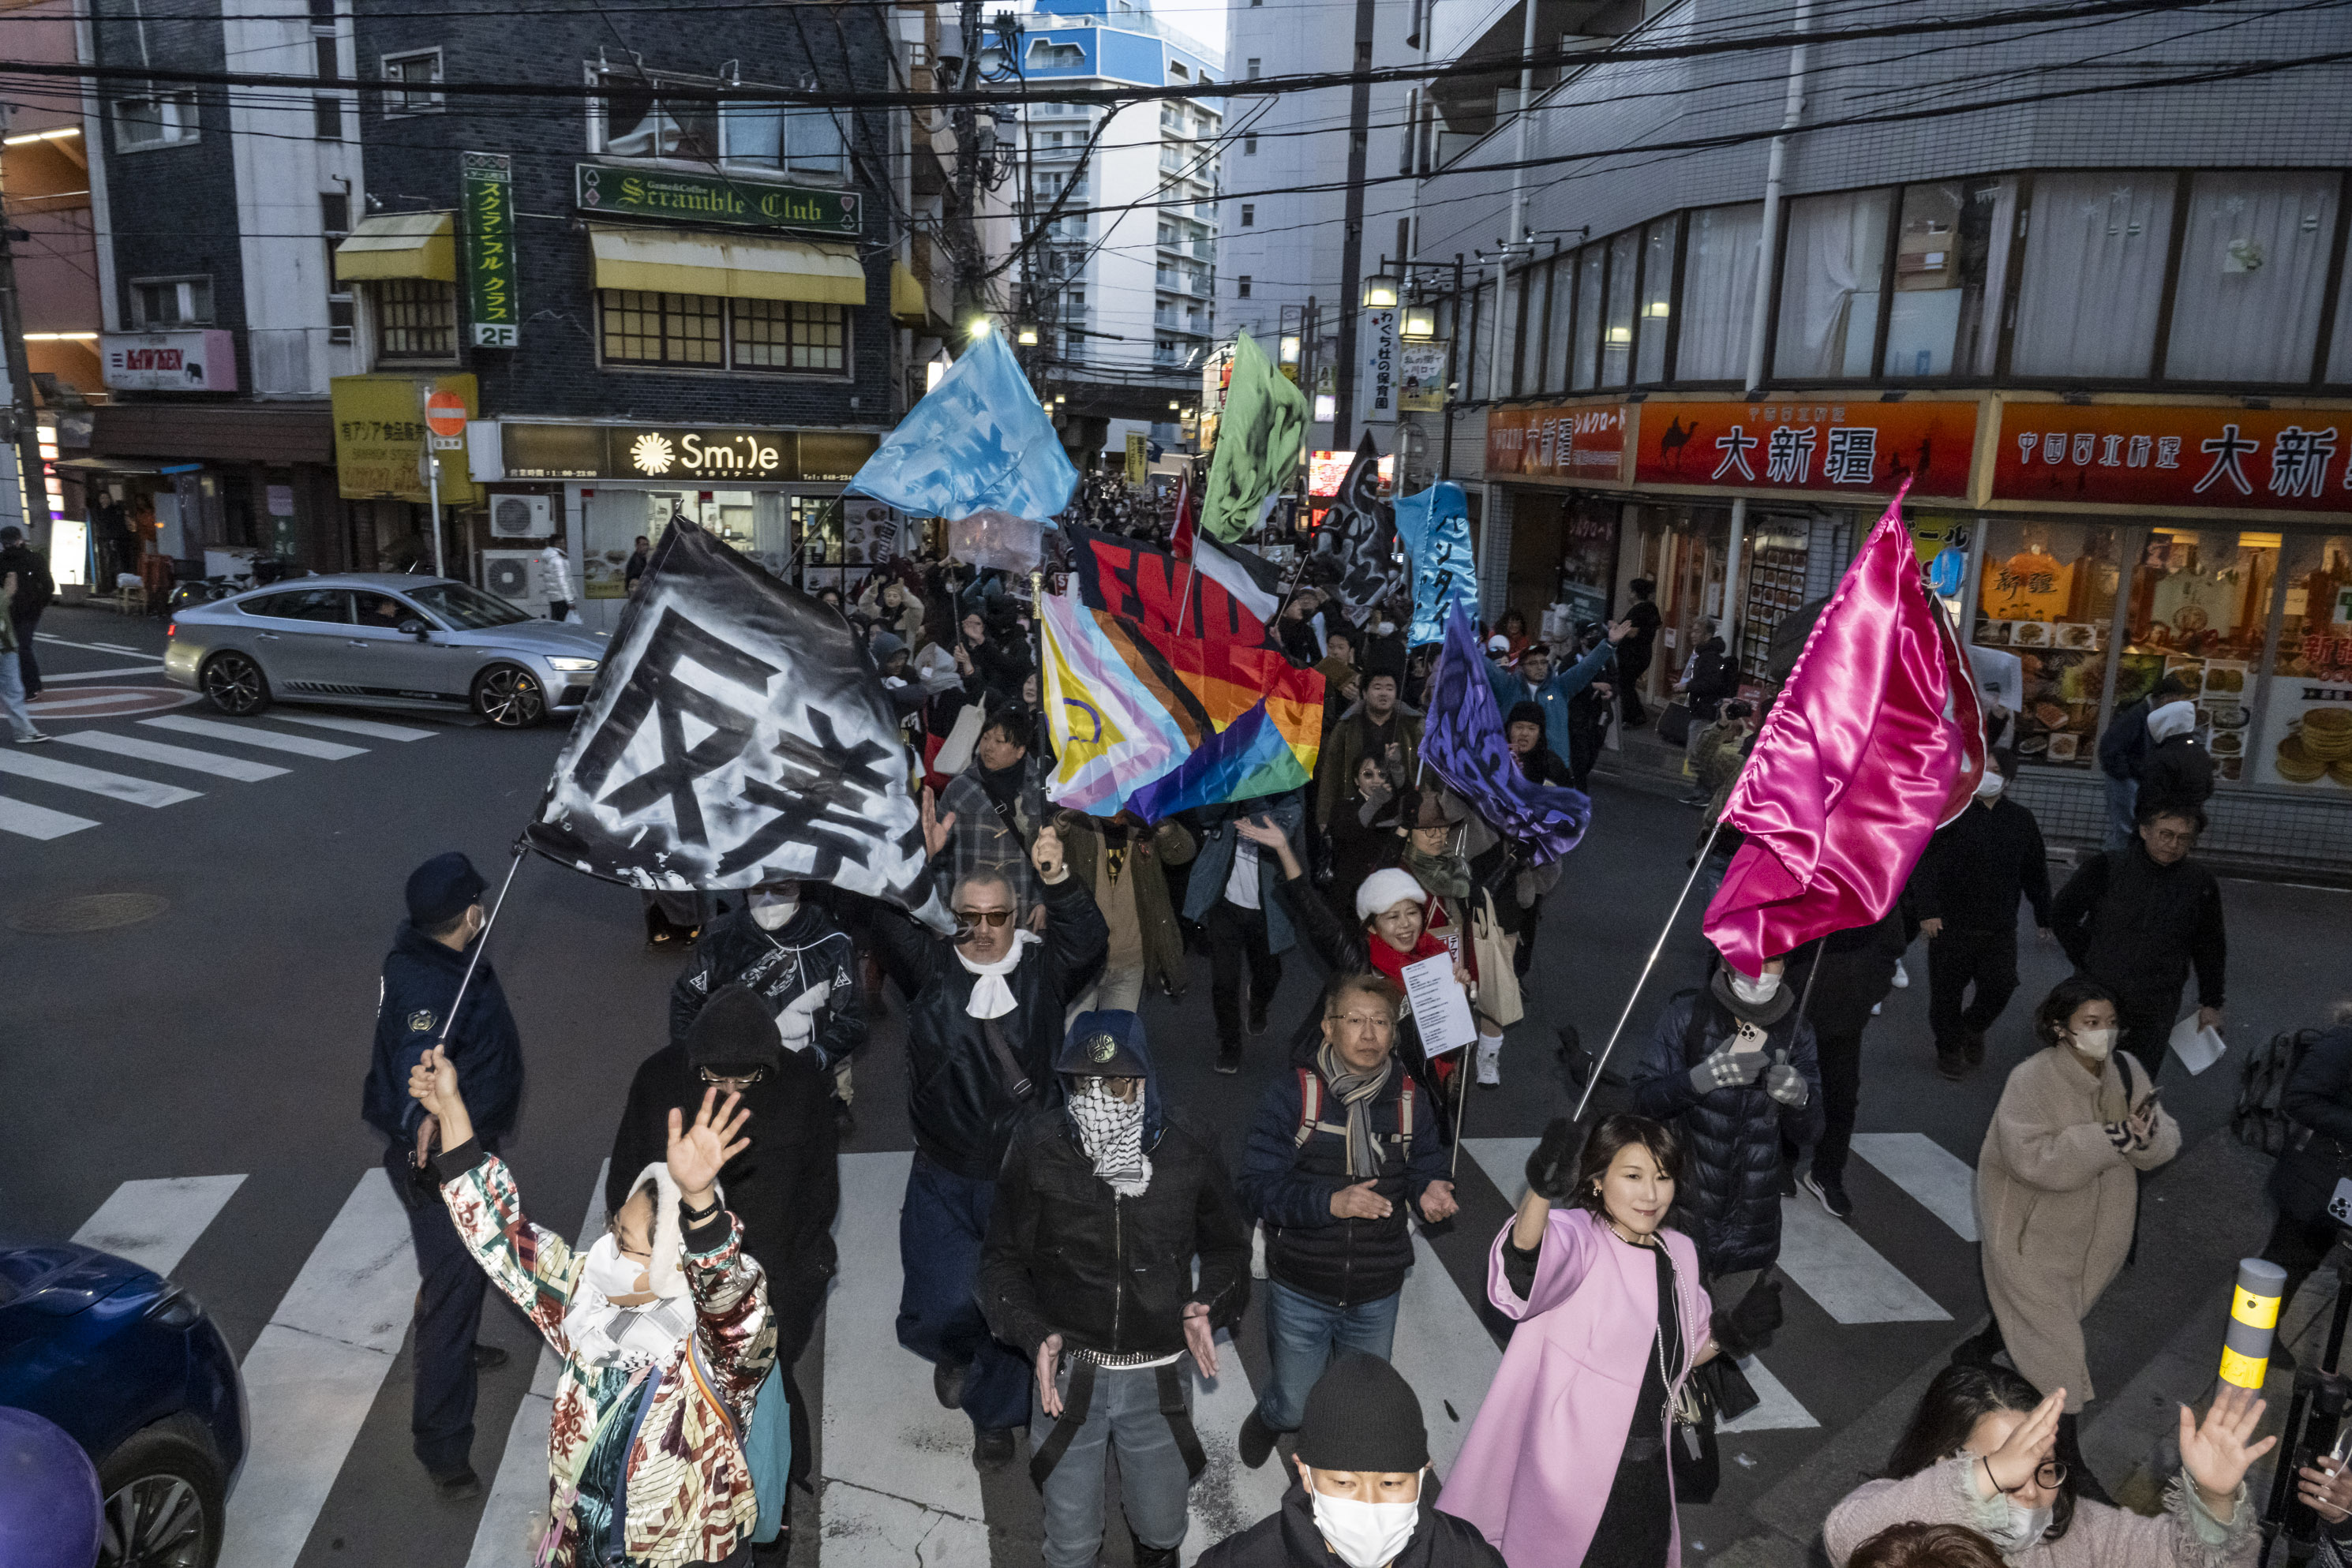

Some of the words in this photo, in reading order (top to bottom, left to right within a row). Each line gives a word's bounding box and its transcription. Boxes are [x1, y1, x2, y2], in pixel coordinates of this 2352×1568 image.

[616, 178, 745, 214] Scramble
[762, 193, 822, 220] Club
[481, 327, 513, 344] 2F
[680, 434, 779, 469] Smile
[1711, 425, 1878, 484] 大新疆
[2018, 432, 2182, 469] 中国西北料理
[2193, 424, 2352, 498] 大新
